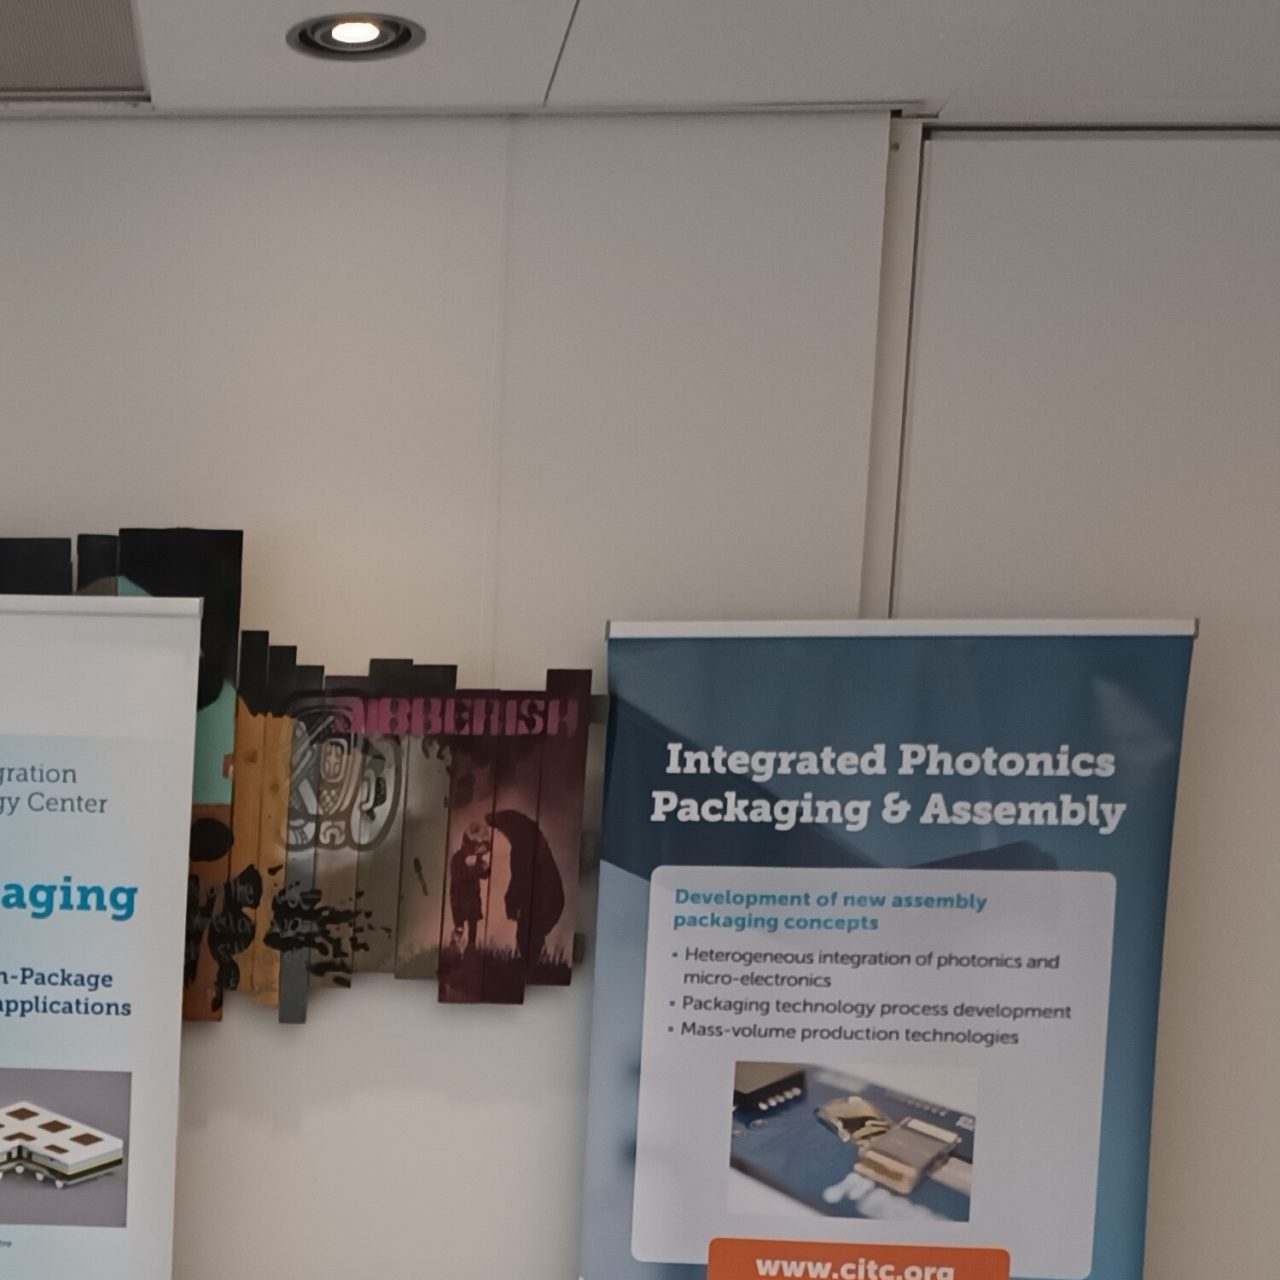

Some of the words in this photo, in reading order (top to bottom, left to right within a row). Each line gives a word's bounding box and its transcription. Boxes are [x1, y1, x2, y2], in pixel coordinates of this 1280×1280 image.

[666, 743, 886, 782] Integrated
[898, 745, 1115, 777] Photonics
[27, 792, 107, 814] Center
[650, 791, 871, 832] Packaging
[882, 794, 911, 823] &
[920, 795, 1126, 834] Assembly
[675, 889, 810, 911] Development
[817, 892, 839, 908] of
[844, 895, 885, 909] new
[892, 893, 987, 913] assembly
[673, 912, 778, 934] packaging
[785, 914, 878, 933] concepts
[684, 947, 814, 967] Heterogeneous
[819, 950, 911, 969] integration
[916, 952, 933, 967] of
[937, 953, 1022, 971] photonics
[1026, 954, 1059, 969] and
[683, 972, 831, 989] micro-electronics
[682, 996, 770, 1015] Packaging
[775, 998, 875, 1018] technology
[880, 1002, 948, 1019] process
[954, 1003, 1071, 1022] development
[681, 1023, 796, 1041] Mass-volume
[801, 1025, 899, 1044] production
[905, 1028, 1019, 1048] technologies
